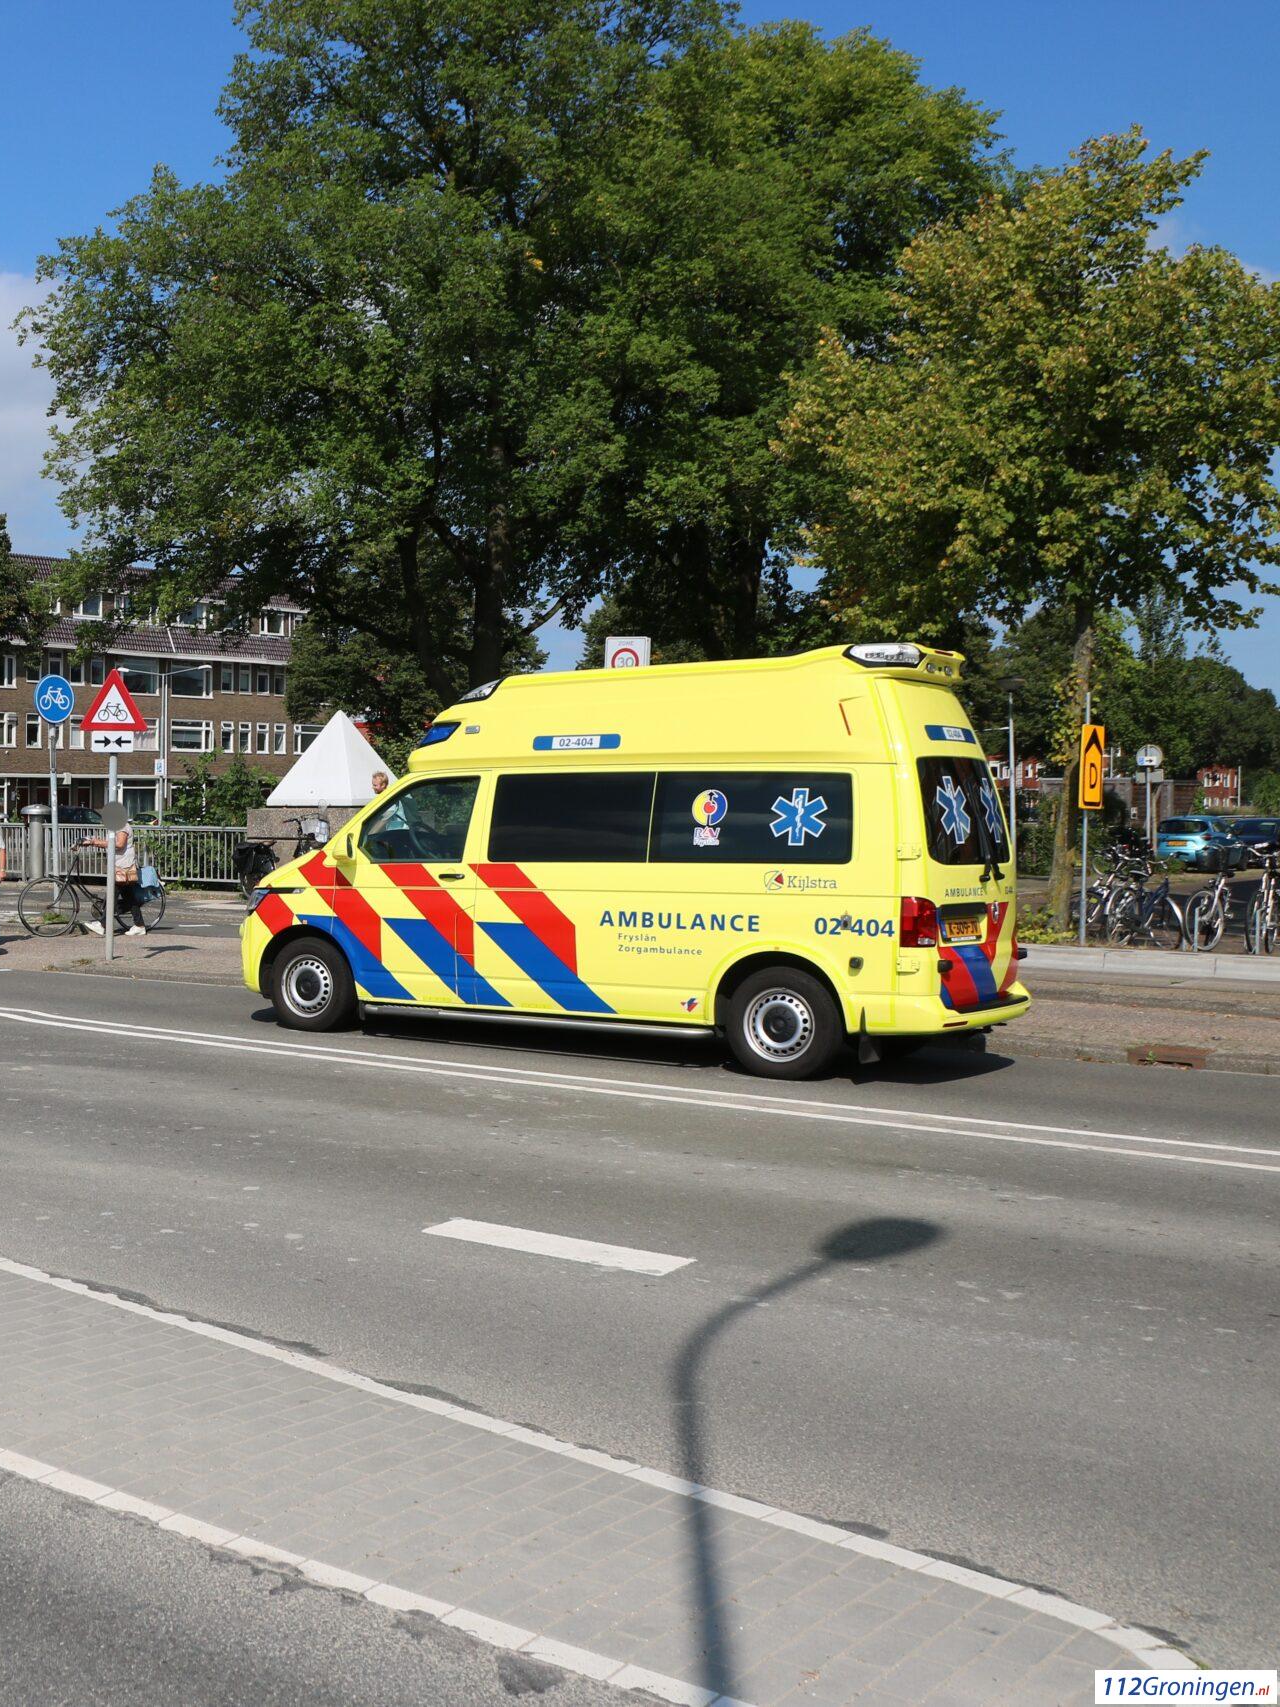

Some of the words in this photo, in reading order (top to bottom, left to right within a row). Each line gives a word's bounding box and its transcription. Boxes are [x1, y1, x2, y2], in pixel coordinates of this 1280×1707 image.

[617, 657, 634, 667] 30
[559, 737, 593, 747] 02-404
[1089, 762, 1098, 789] D
[787, 875, 837, 892] Kijlstra
[945, 887, 984, 898] AMBULANCE
[600, 910, 760, 932] AMBULANCE
[814, 917, 895, 937] 02404
[618, 944, 703, 956] Zorgambulance
